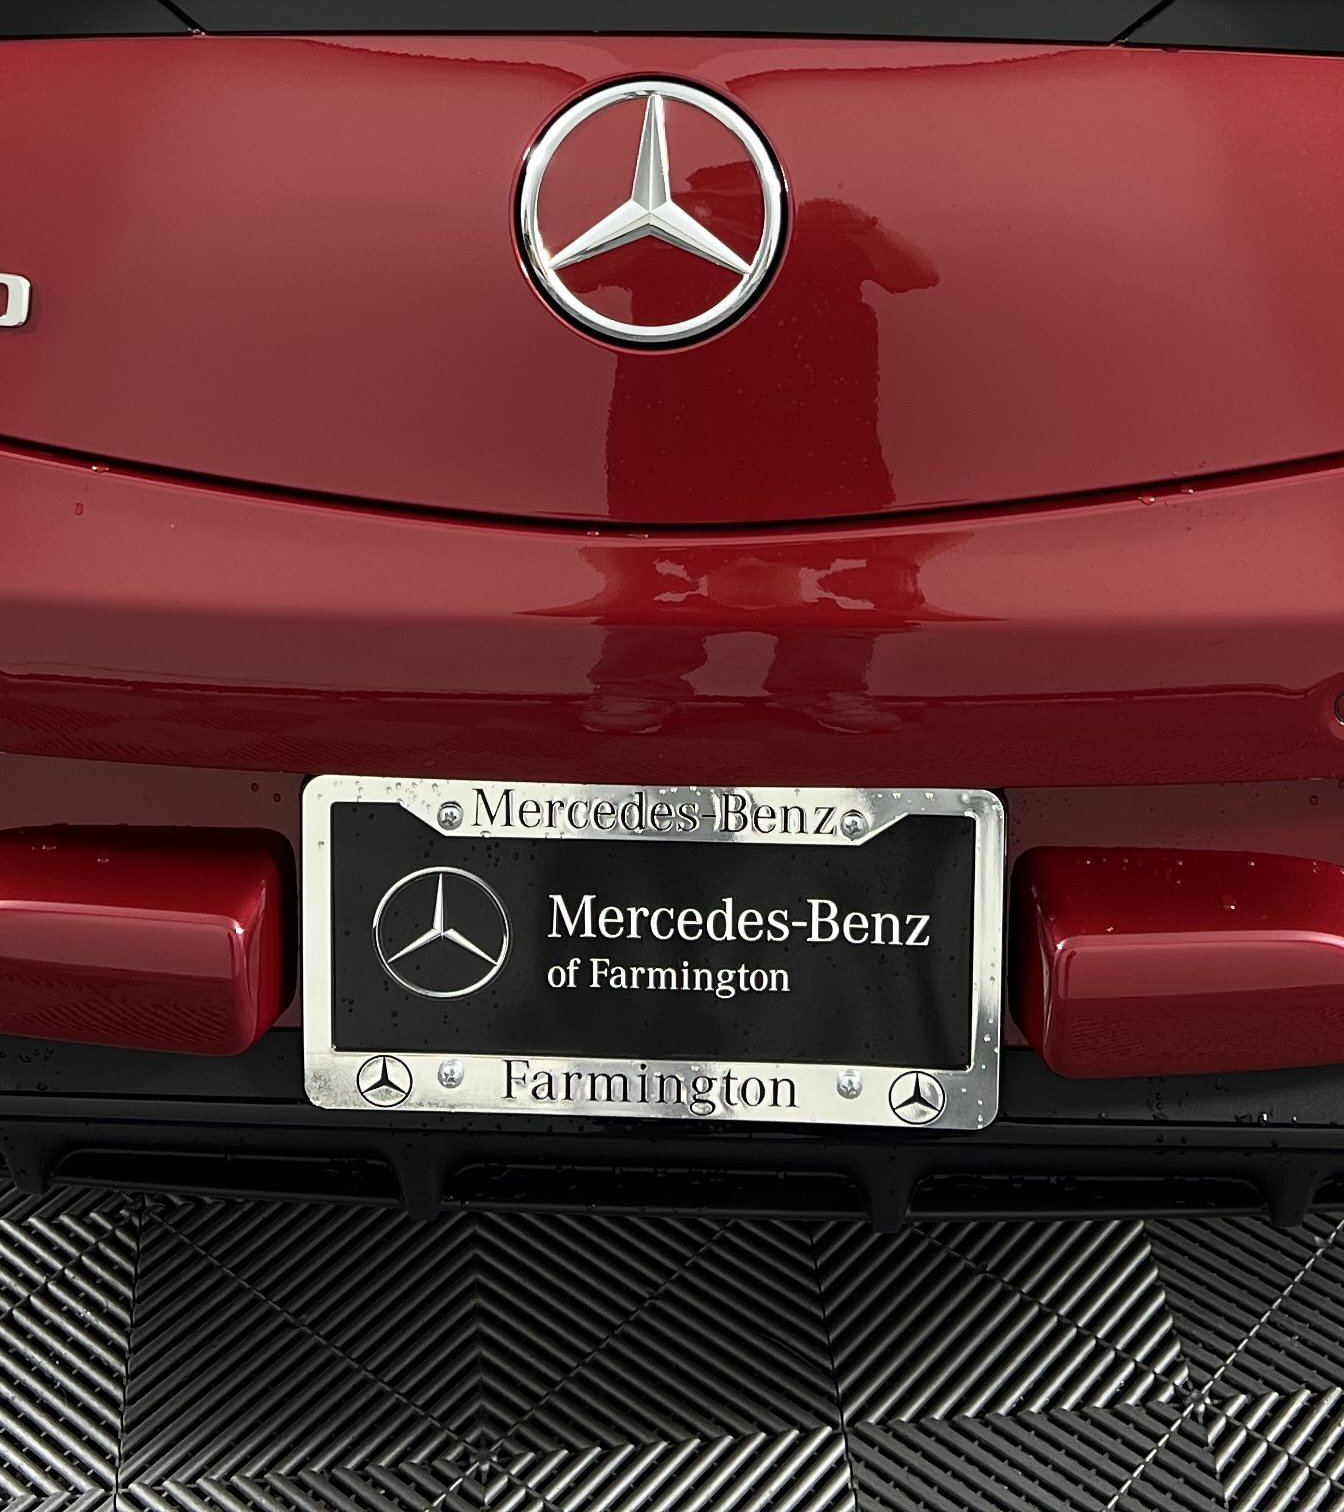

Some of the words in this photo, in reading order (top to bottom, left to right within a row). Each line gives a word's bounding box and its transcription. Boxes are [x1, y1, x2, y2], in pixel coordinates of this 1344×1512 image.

[472, 788, 838, 835] Mercedes-Benz
[547, 894, 931, 946] Mercedes-Benz
[547, 958, 580, 988] of
[590, 960, 790, 999] Farmington
[503, 1059, 799, 1114] Farmington
